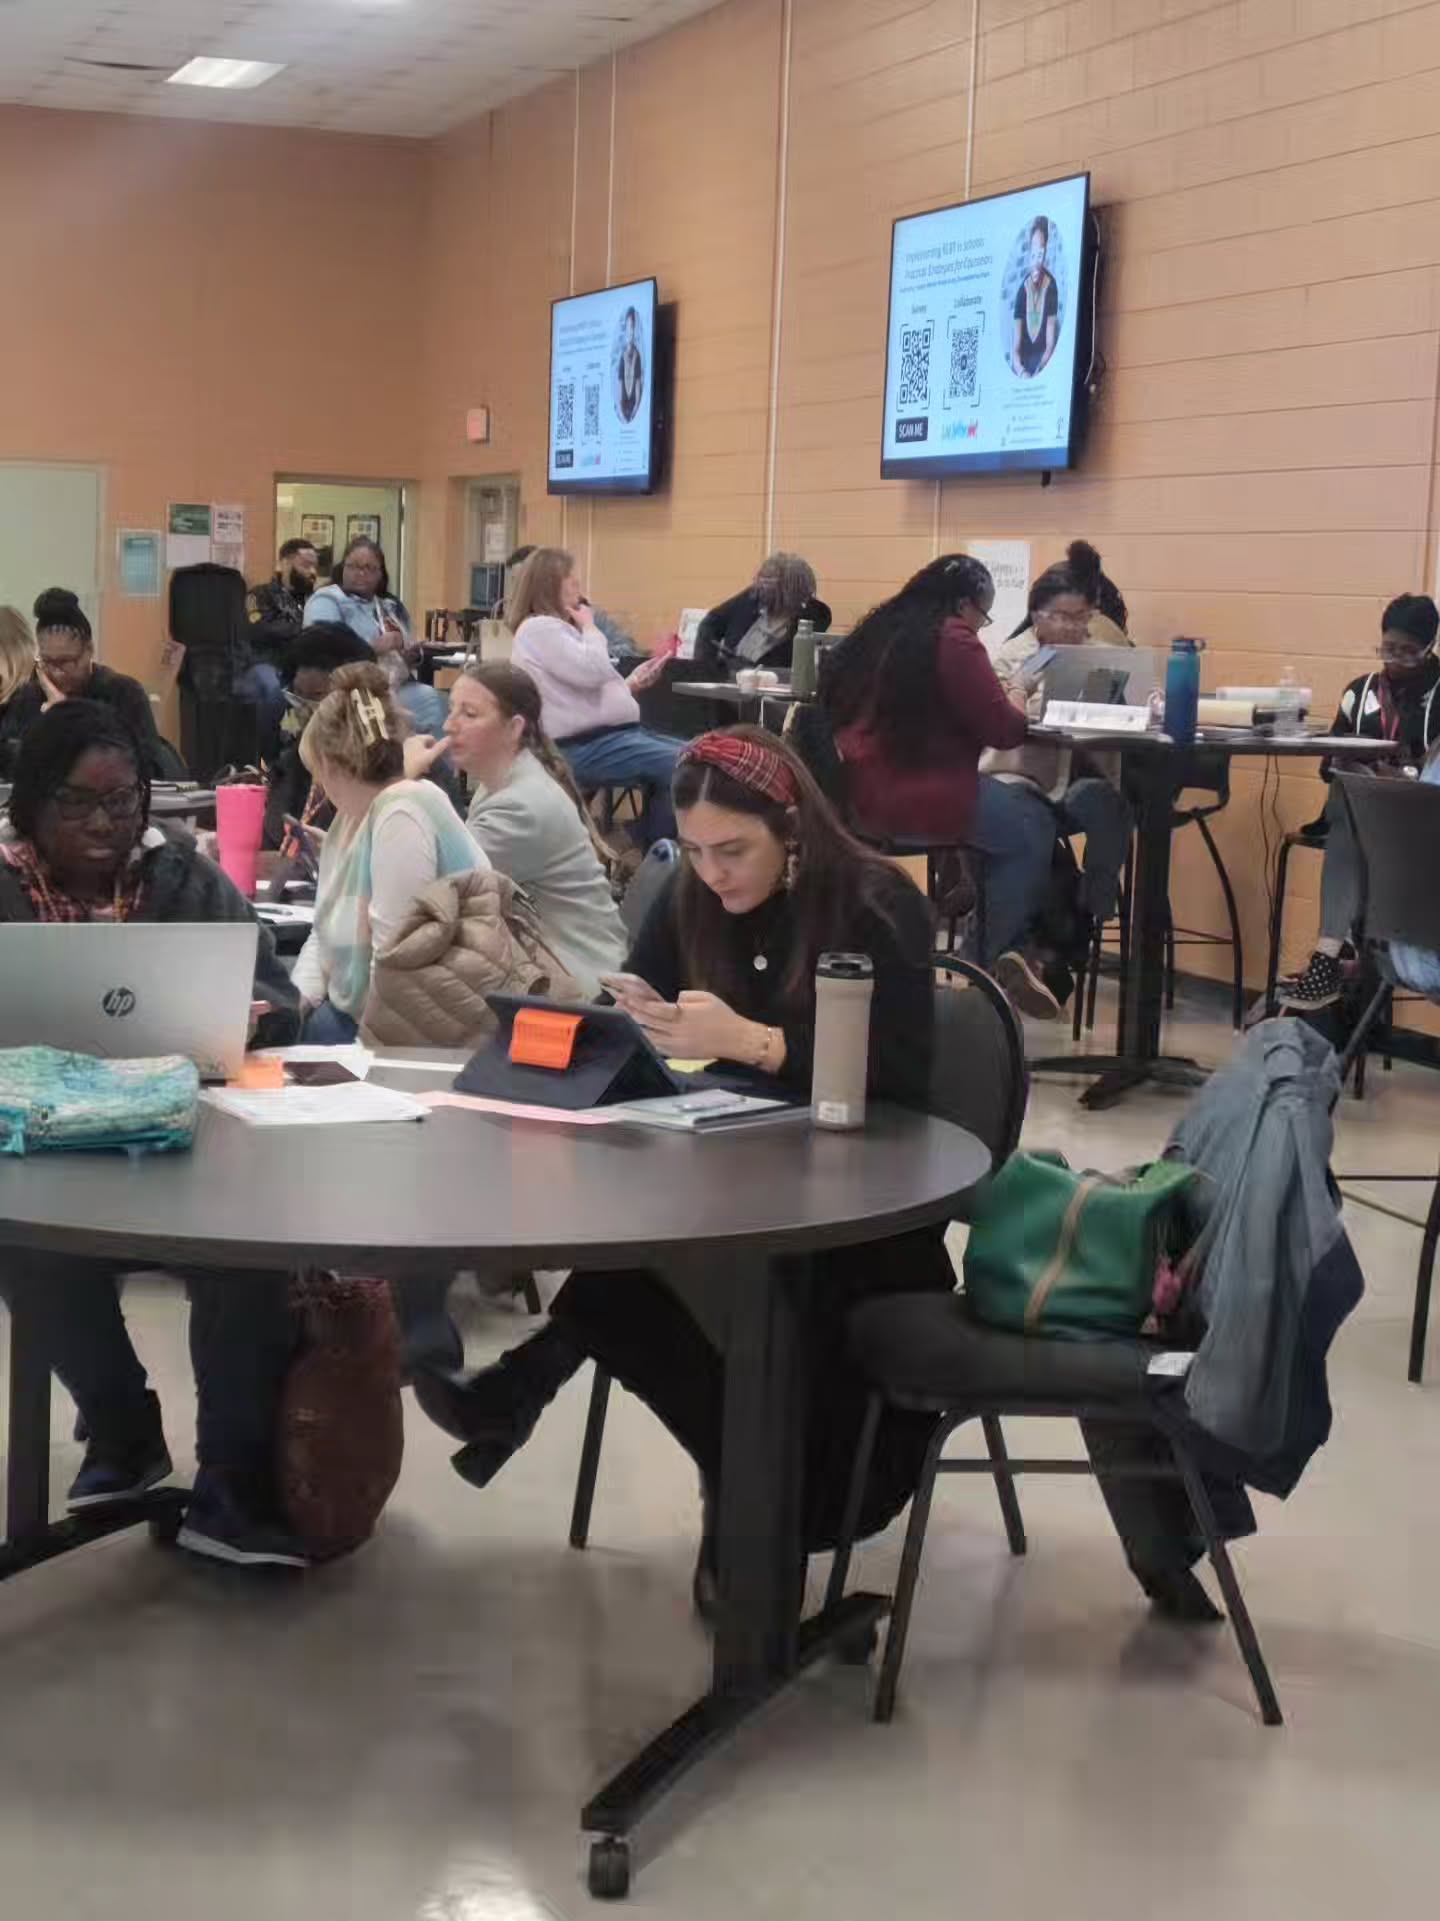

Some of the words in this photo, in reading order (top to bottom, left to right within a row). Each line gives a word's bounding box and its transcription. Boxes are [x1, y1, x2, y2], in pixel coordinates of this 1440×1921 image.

[898, 424, 914, 440] SCAN
[914, 422, 924, 437] ME
[104, 988, 134, 1017] hp
